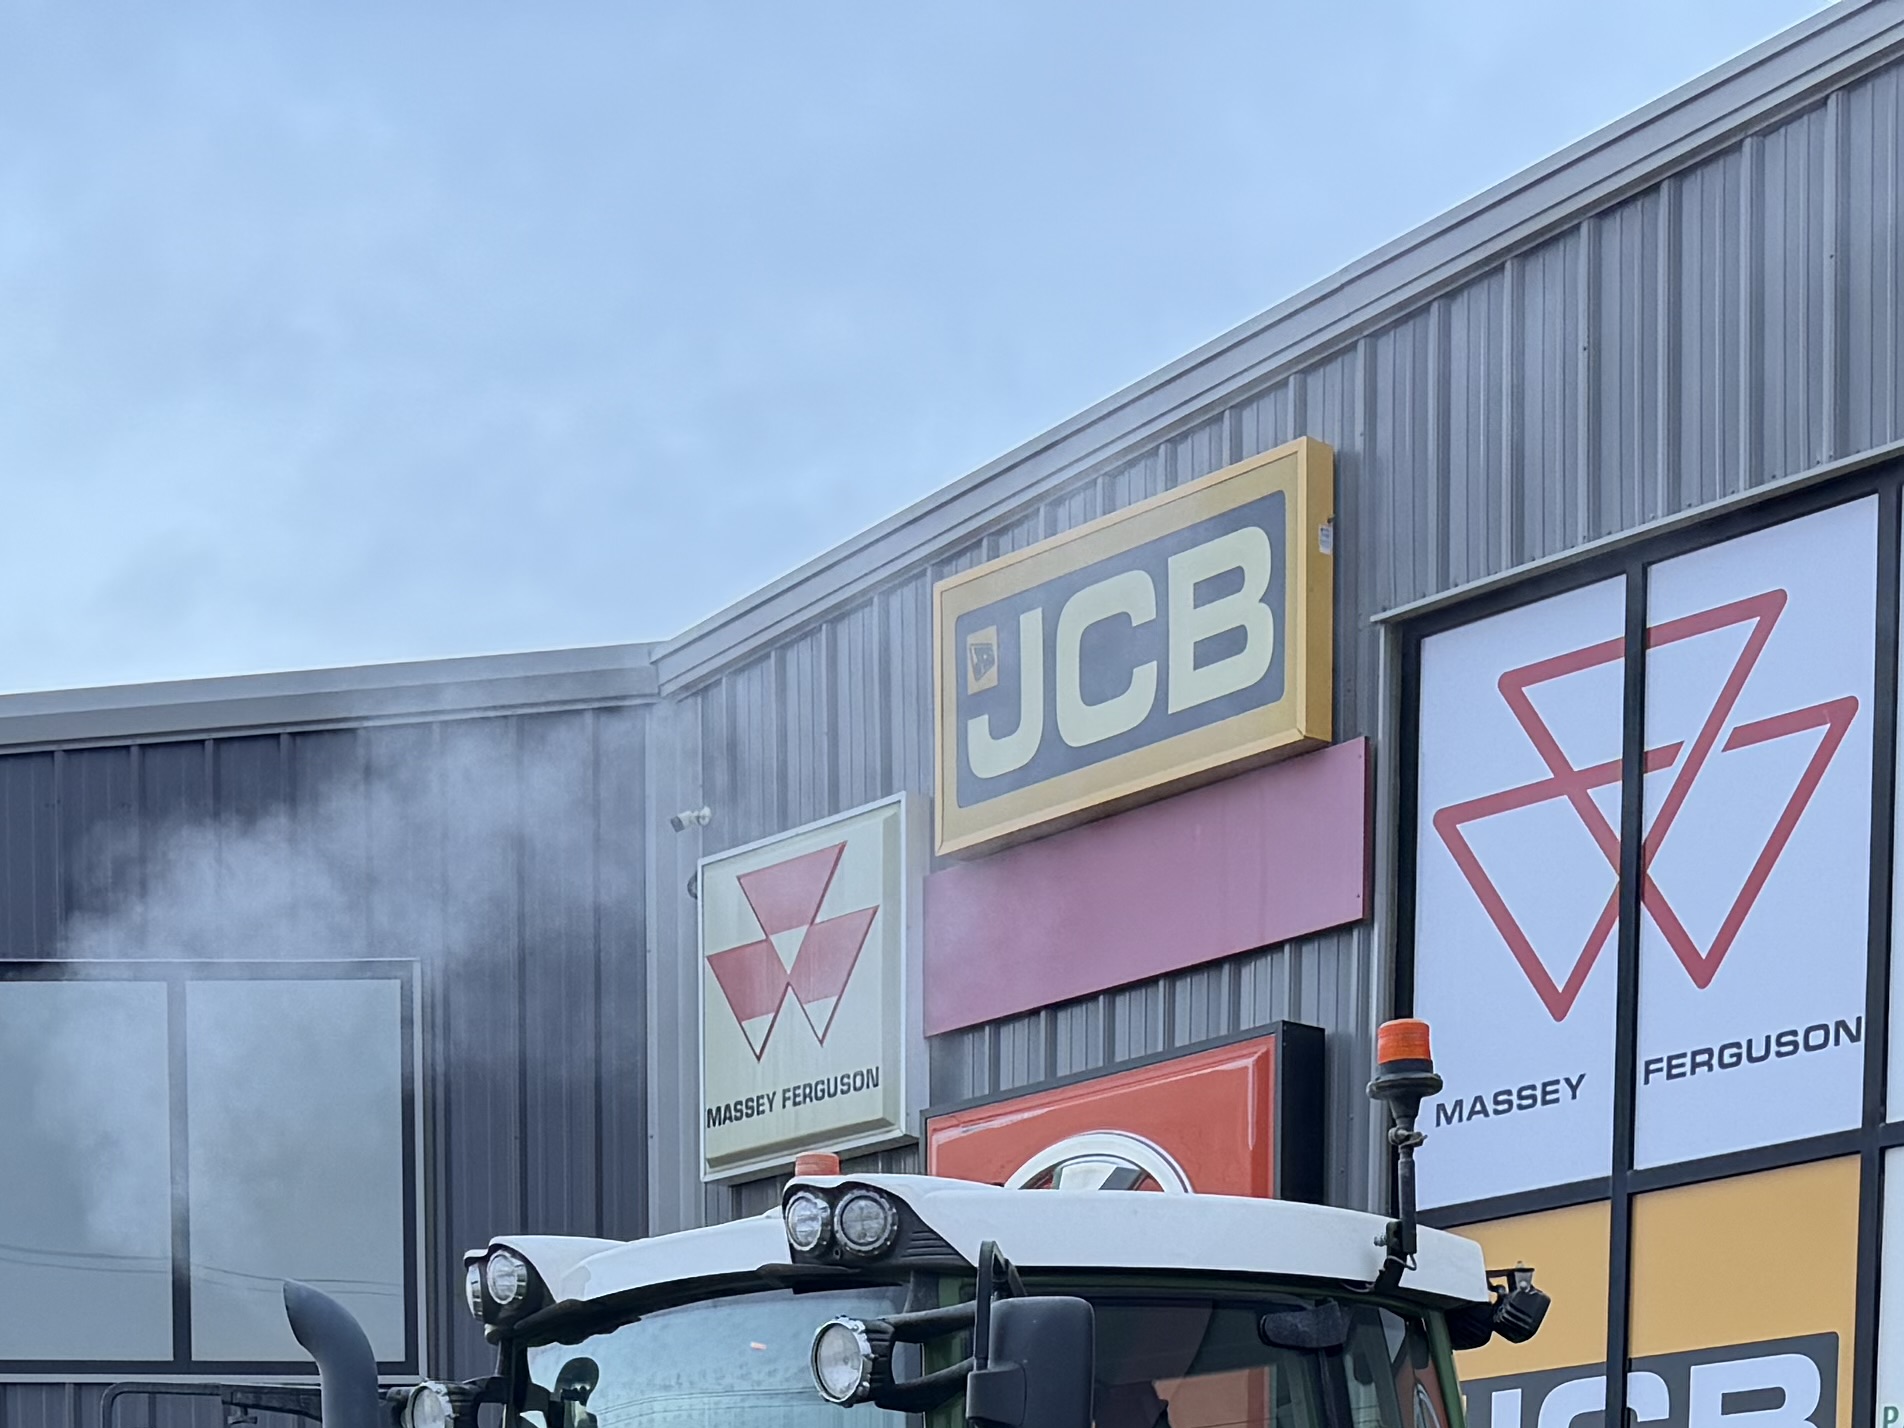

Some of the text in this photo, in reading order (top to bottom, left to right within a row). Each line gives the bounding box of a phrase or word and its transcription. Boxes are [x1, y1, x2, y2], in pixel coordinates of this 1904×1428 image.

[967, 525, 1274, 778] JCB
[707, 1066, 880, 1128] MASSEY FERGUSON
[1435, 1015, 1864, 1129] MASSEY FERGUSON
